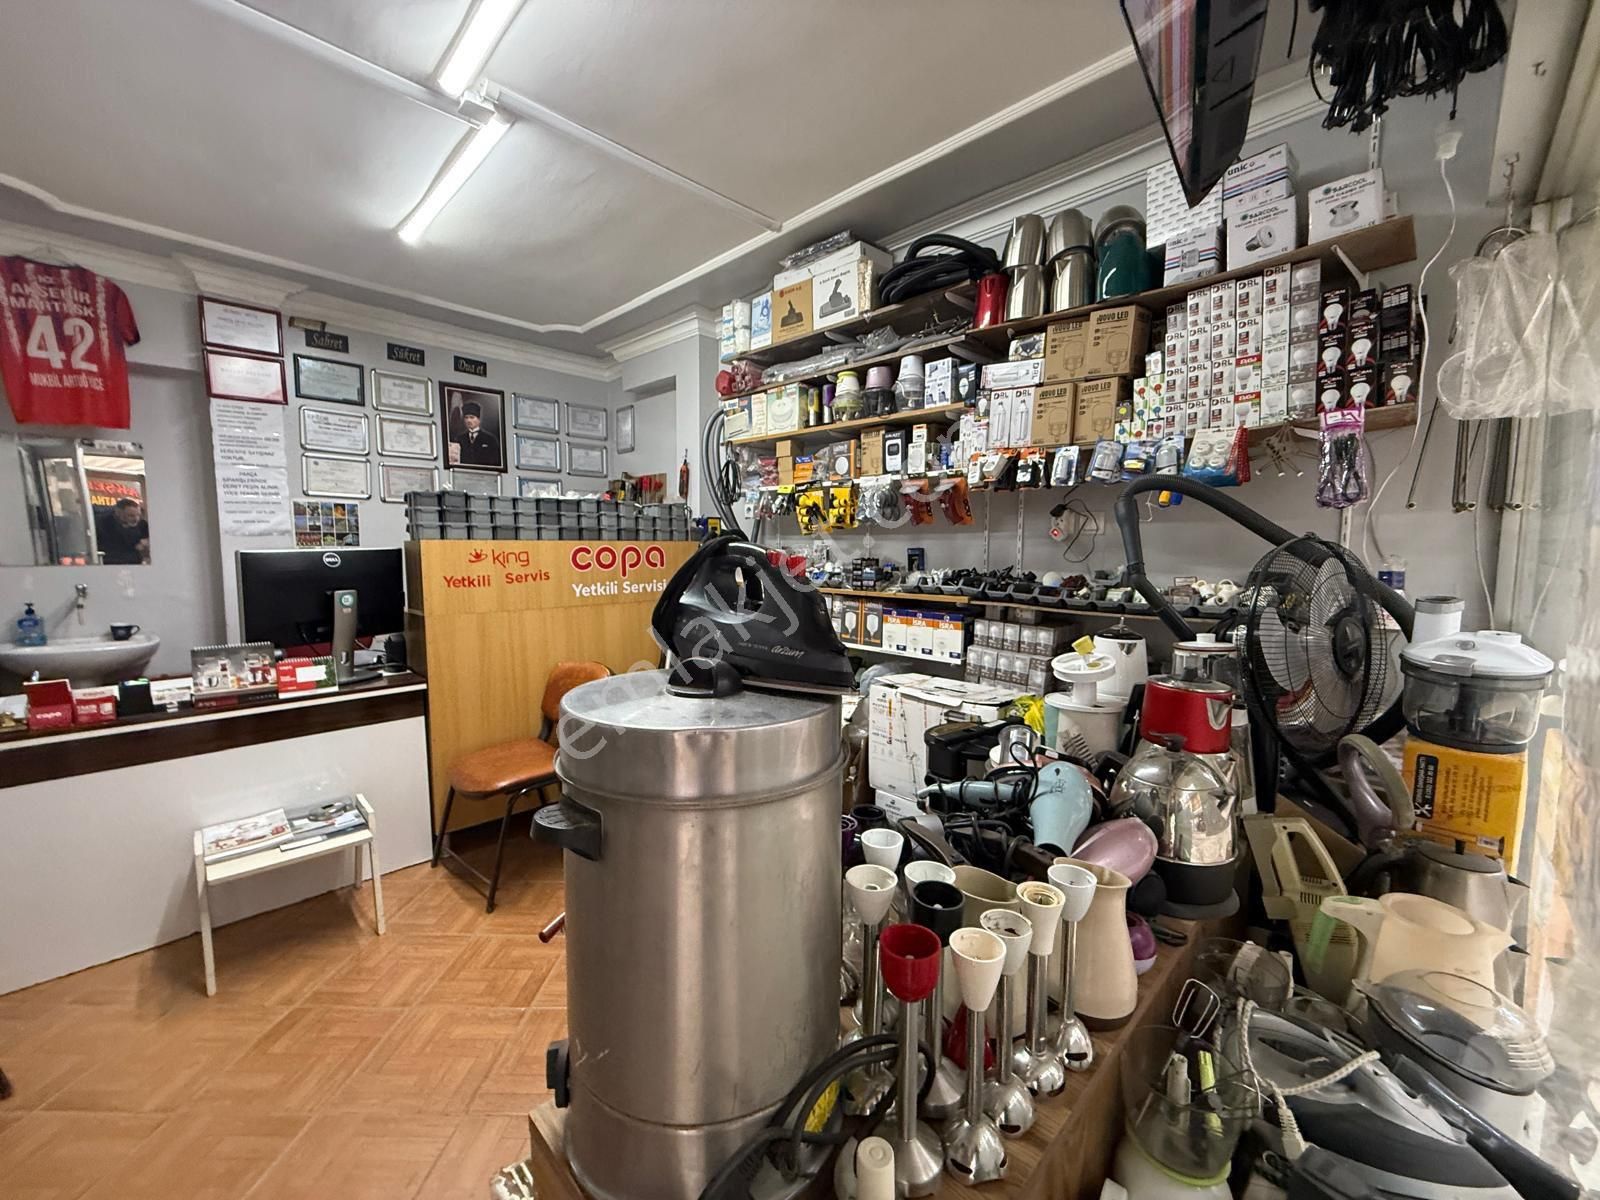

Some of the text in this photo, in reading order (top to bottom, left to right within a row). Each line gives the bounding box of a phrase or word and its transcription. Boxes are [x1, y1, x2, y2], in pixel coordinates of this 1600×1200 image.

[26, 315, 98, 372] 42
[492, 549, 530, 568] king
[571, 544, 665, 578] copa
[443, 569, 550, 588] Yetkili Servis
[572, 577, 667, 598] Yetkili Servisi
